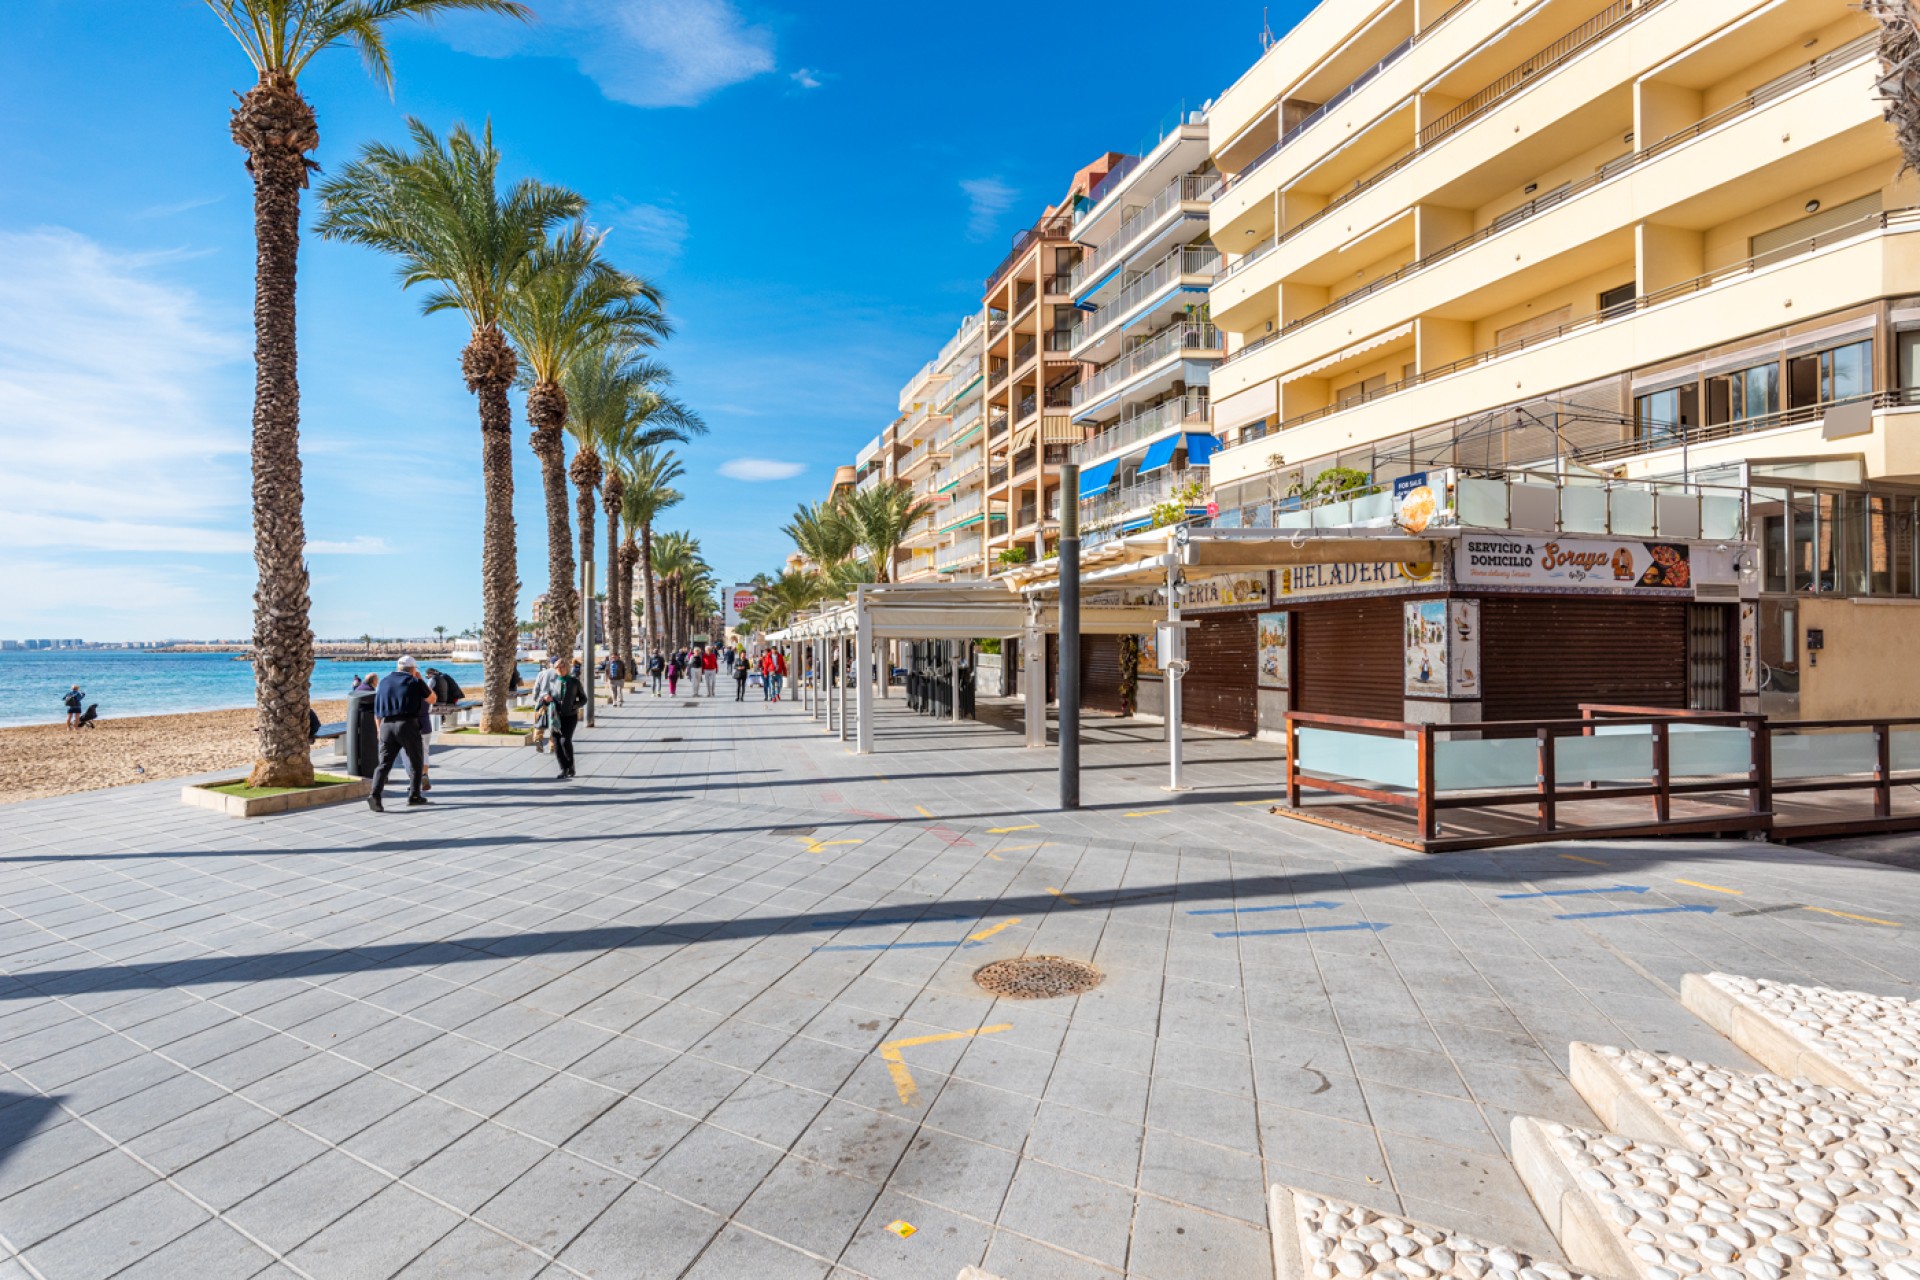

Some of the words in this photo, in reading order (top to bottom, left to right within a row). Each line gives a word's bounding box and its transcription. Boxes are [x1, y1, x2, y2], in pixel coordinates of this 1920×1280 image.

[1468, 542, 1522, 554] SERVICIO
[1525, 544, 1535, 555] A
[1541, 542, 1610, 571] Soraya
[1471, 555, 1533, 567] DOMICILIO
[1293, 562, 1404, 589] HELADERI
